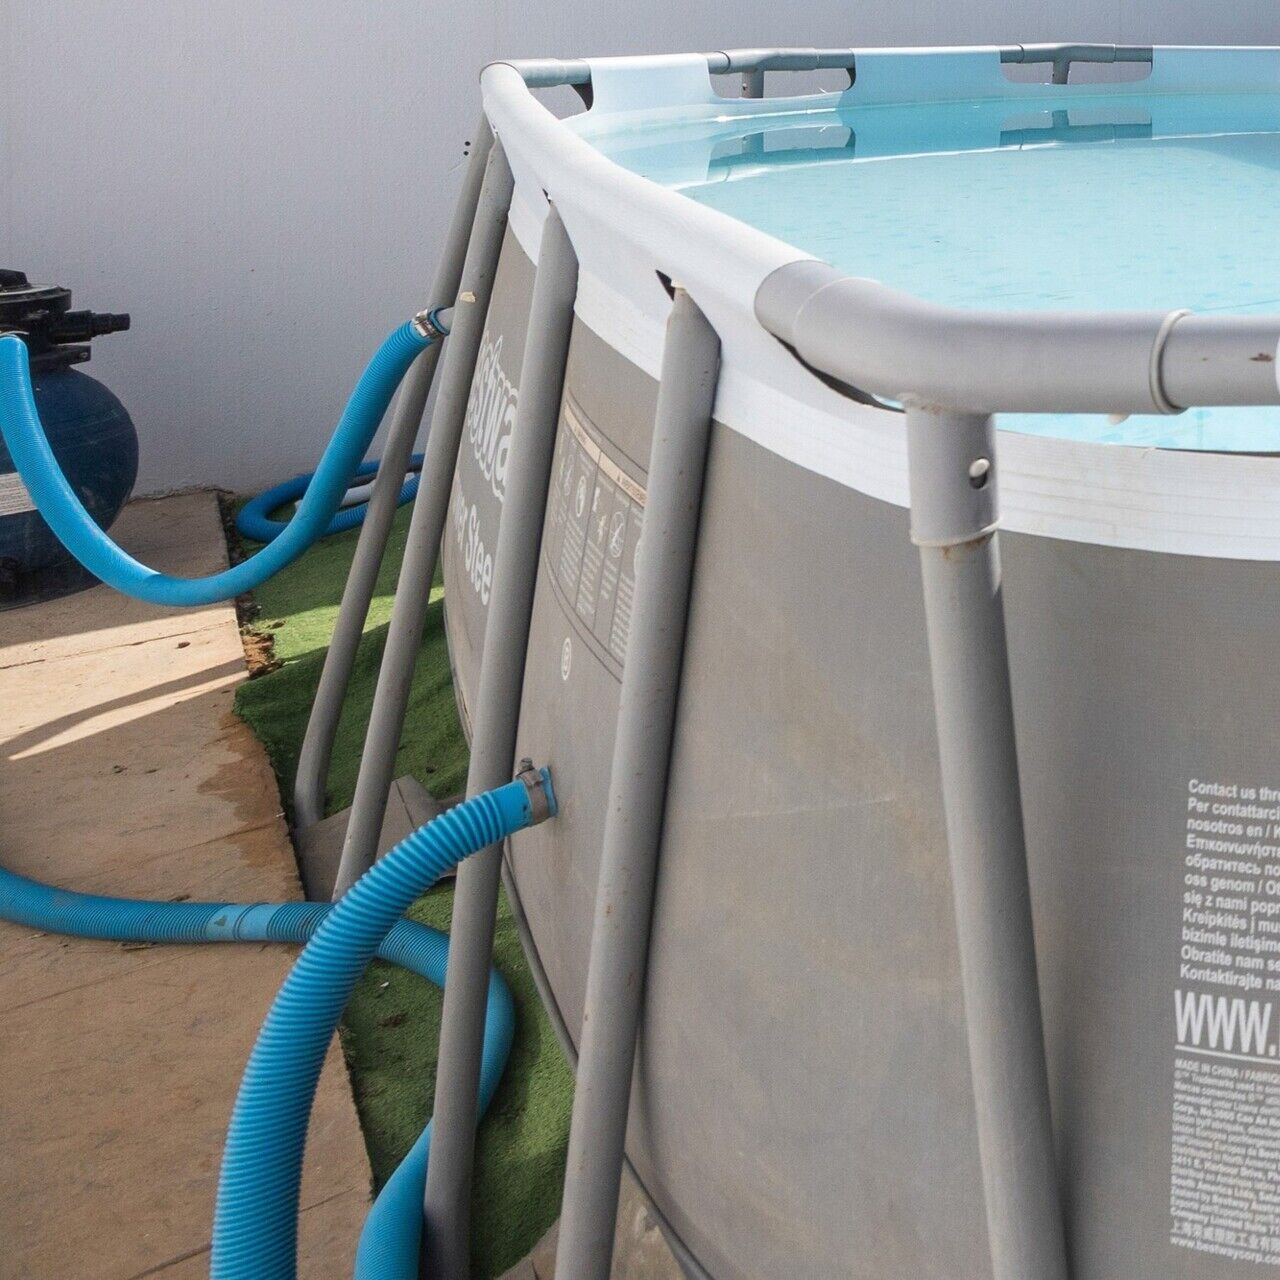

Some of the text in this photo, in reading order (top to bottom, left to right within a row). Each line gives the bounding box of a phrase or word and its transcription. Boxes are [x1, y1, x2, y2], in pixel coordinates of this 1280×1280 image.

[465, 504, 492, 606] Stee
[1187, 778, 1238, 797] Contact
[1240, 787, 1256, 799] us
[1186, 796, 1210, 813] Per
[1186, 818, 1243, 835] nosotros
[1246, 825, 1263, 837] en
[1184, 853, 1262, 874] обратитесь
[1183, 873, 1208, 887] oss
[1210, 877, 1255, 892] genom
[1204, 895, 1213, 906] z
[1215, 896, 1248, 910] nami
[1180, 944, 1232, 965] Obratite
[1234, 955, 1264, 969] nam
[1179, 963, 1263, 990] Kontaktirajte
